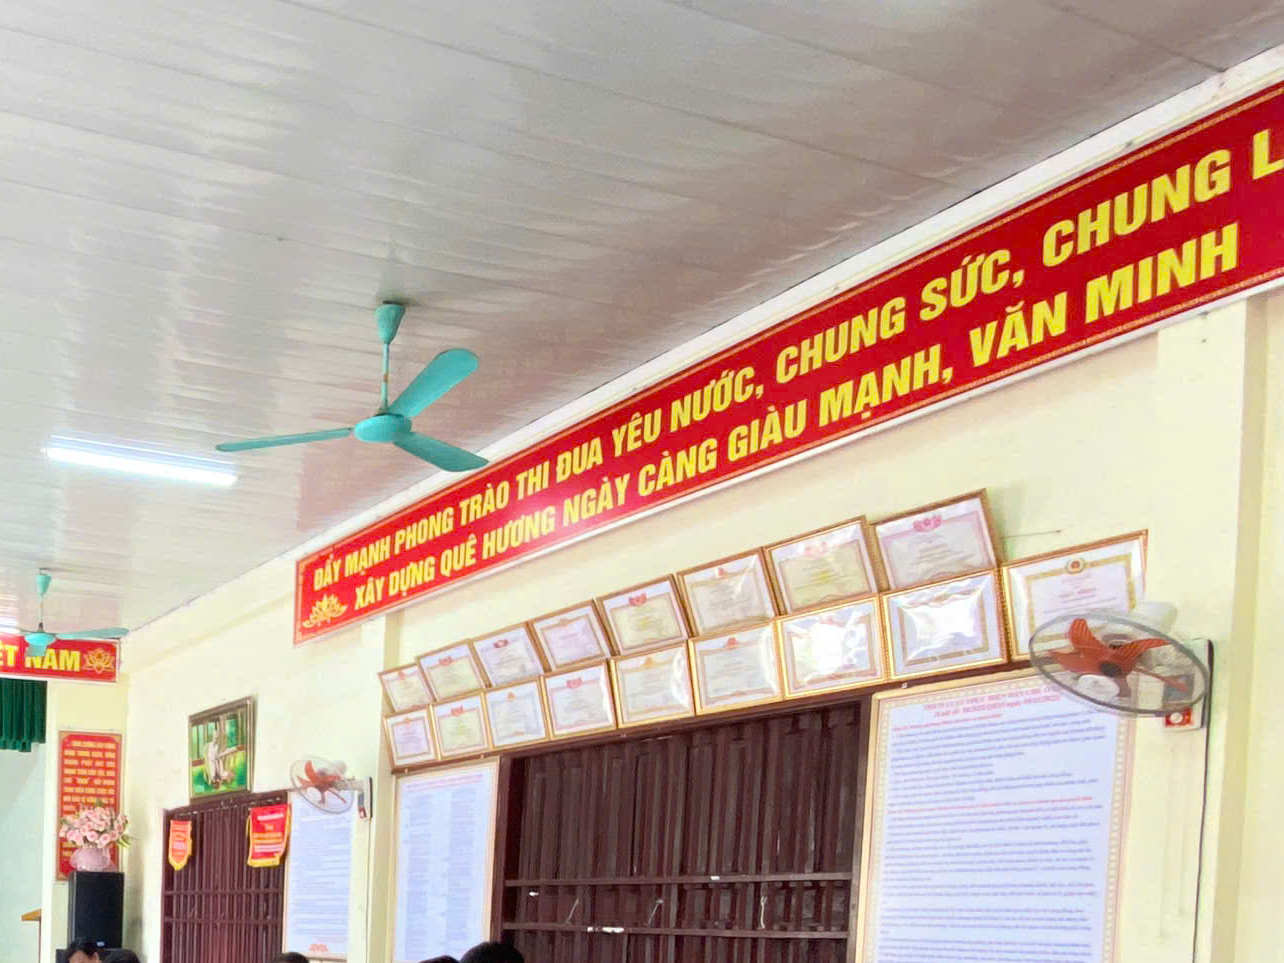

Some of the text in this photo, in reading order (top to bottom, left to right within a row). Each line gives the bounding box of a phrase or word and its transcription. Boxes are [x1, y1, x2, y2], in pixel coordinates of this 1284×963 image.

[313, 553, 342, 591] ĐẨY
[344, 535, 392, 576] MẠNH
[394, 506, 454, 555] PHONG
[459, 480, 510, 526] TRÀO
[516, 460, 550, 500] THI
[556, 437, 604, 483] ĐUA
[612, 408, 662, 457] YÊU
[669, 366, 765, 433] NƯỚC,
[776, 296, 907, 384] CHUNG
[919, 249, 1025, 321] SỨC,
[1042, 149, 1232, 267] CHUNG
[355, 222, 1238, 610] XÂY DỰNG QUÊ HƯƠNG NGÀY CÀNG GIÀU MẠNH, VĂN MINH
[25, 648, 82, 672] NAM
